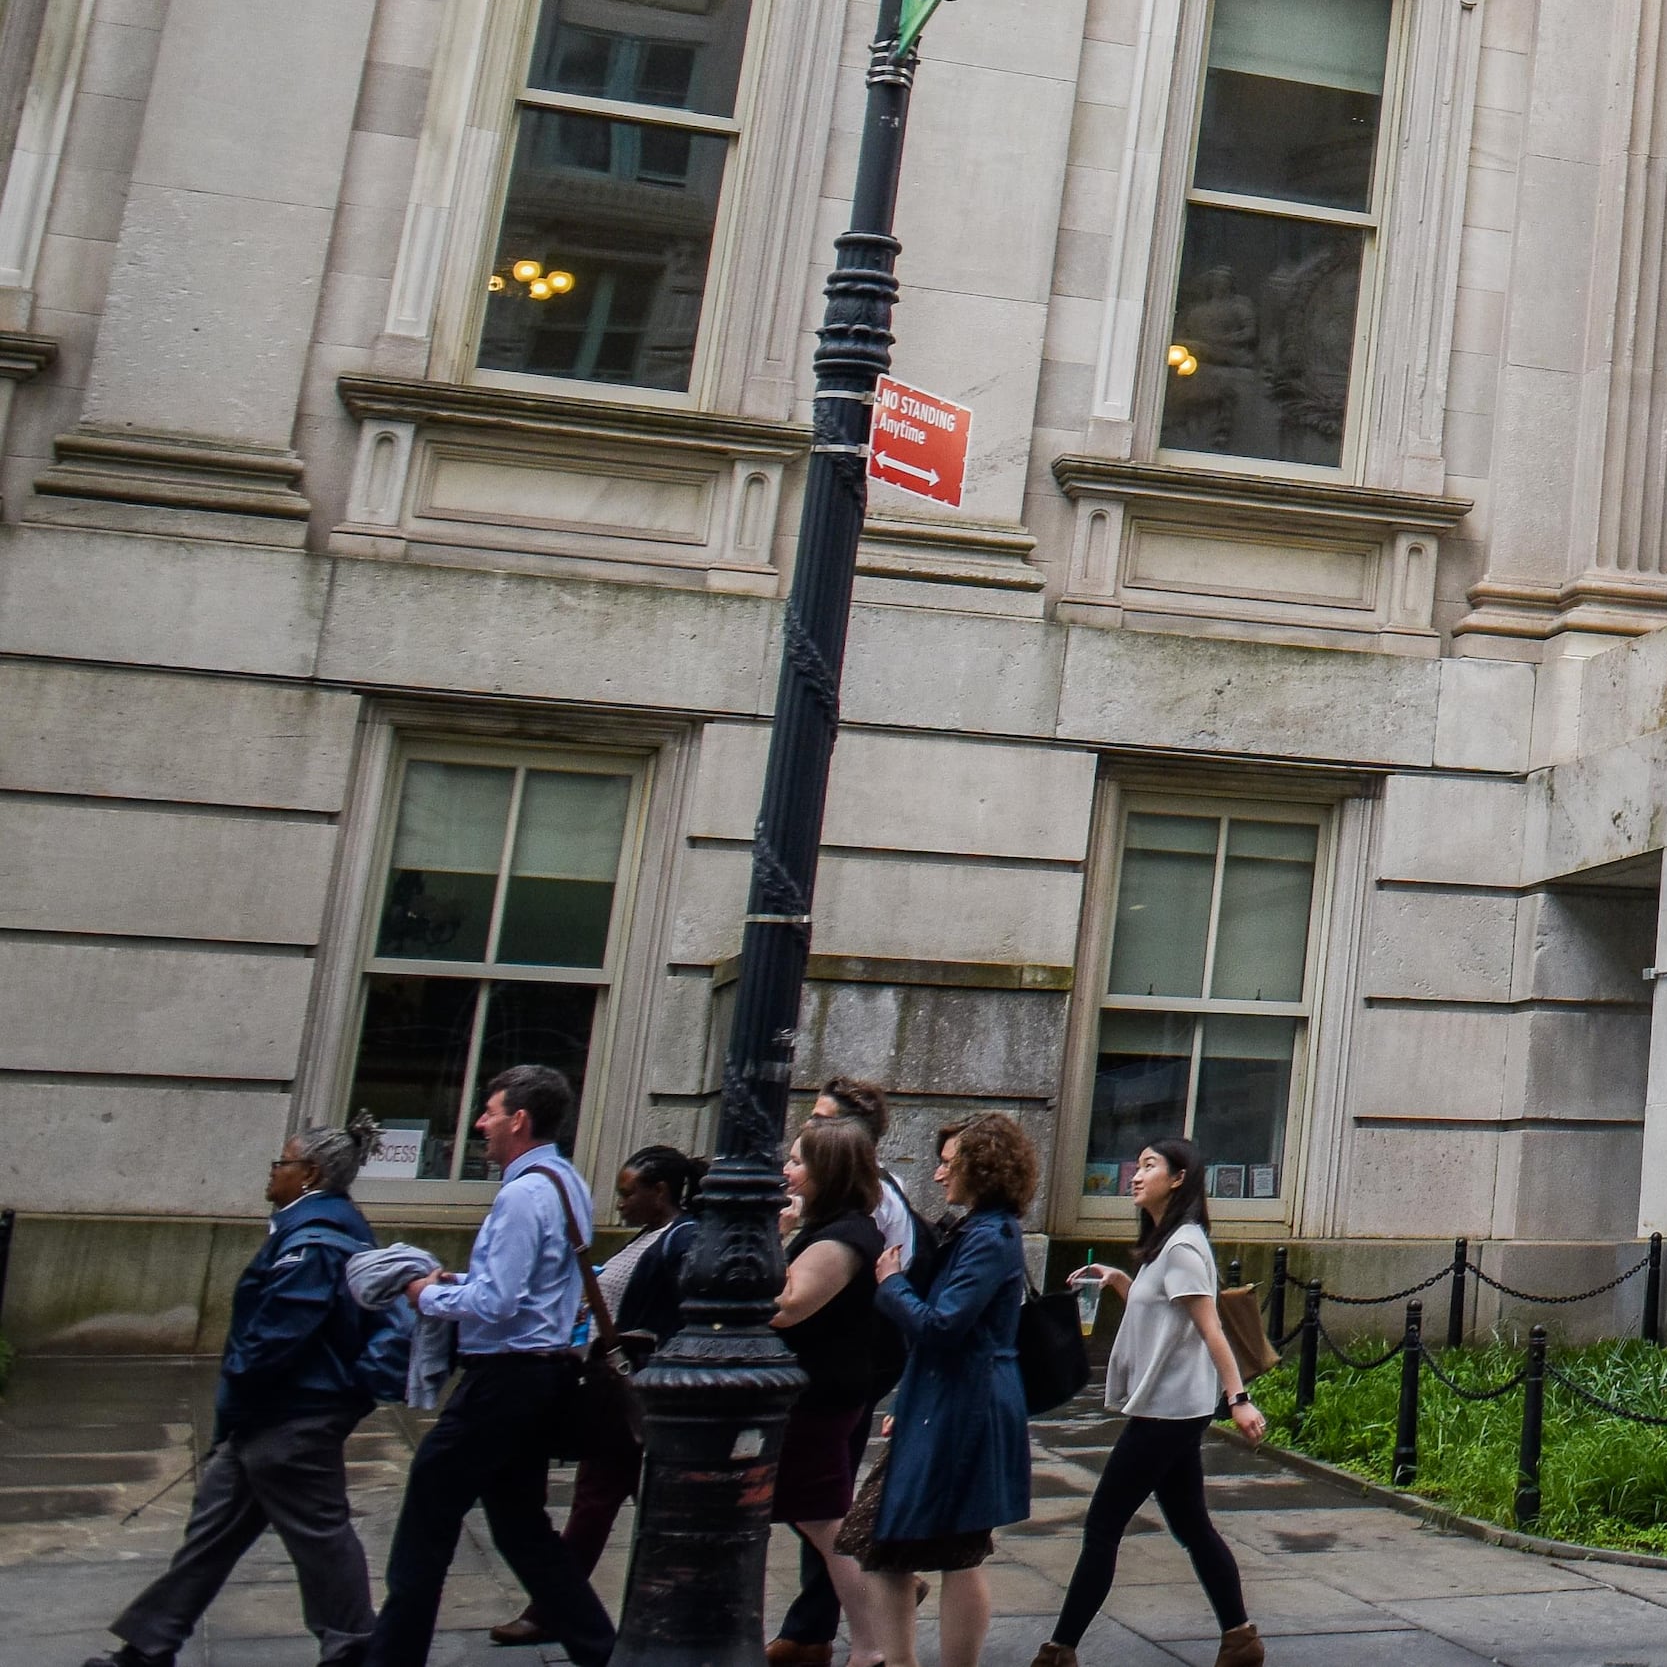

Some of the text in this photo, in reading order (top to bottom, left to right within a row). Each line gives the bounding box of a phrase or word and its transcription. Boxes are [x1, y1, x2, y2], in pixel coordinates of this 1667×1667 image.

[879, 413, 926, 445] Anytime
[881, 388, 956, 432] NO STANDING
